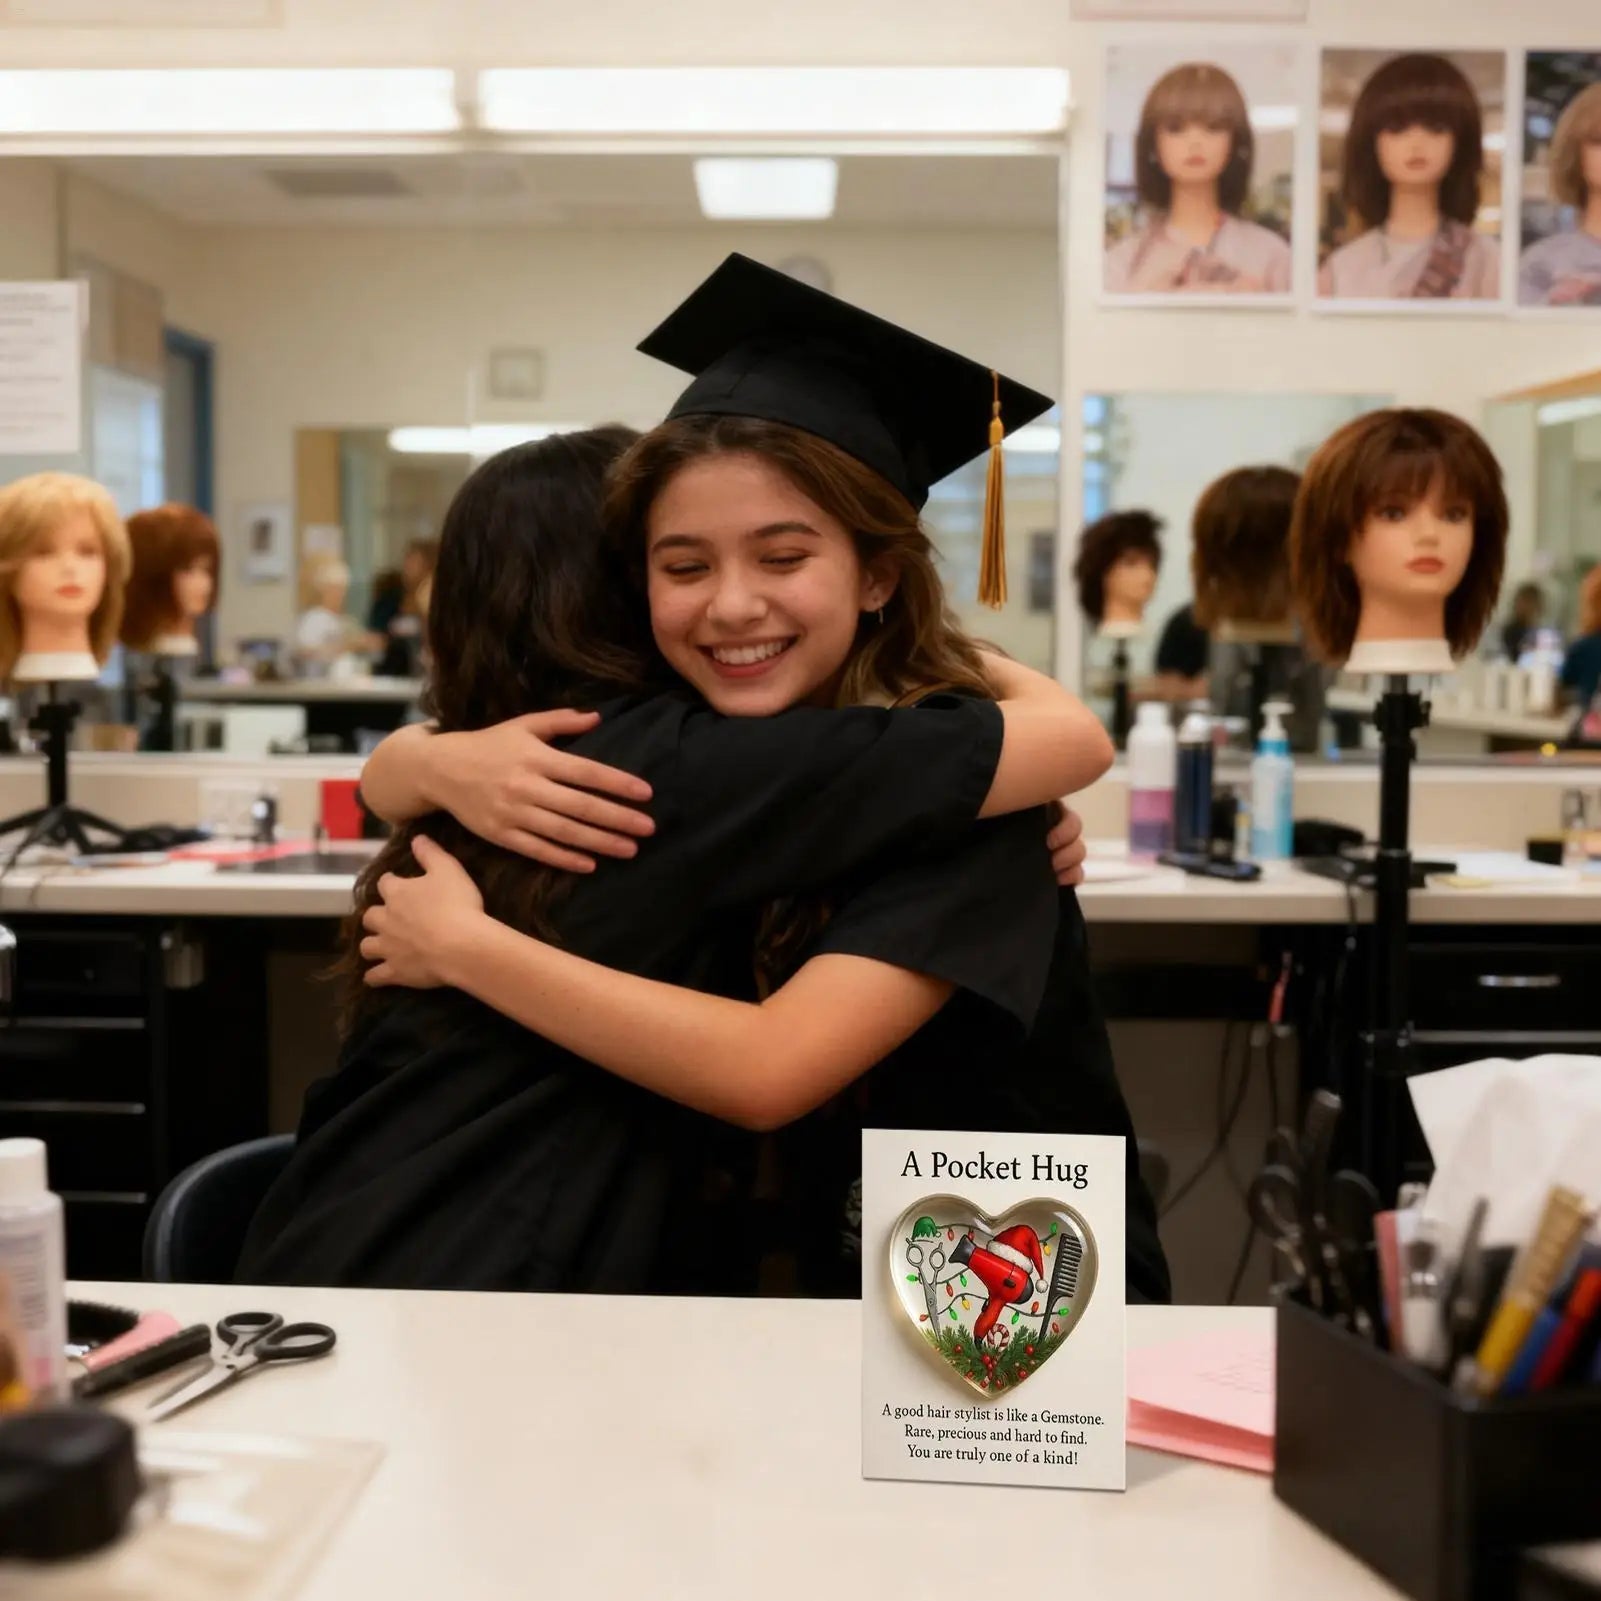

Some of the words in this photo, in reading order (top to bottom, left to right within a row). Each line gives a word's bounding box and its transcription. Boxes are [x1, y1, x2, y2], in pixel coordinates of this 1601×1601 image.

[900, 1150, 922, 1177] A
[931, 1151, 1022, 1180] Pocket
[1032, 1154, 1088, 1190] Hug
[882, 1403, 892, 1416] A
[894, 1404, 924, 1420] good
[927, 1404, 951, 1418] hair
[954, 1406, 991, 1423] stylist
[994, 1408, 1004, 1421] is
[1006, 1408, 1028, 1422] like
[1031, 1413, 1038, 1422] a
[1041, 1410, 1104, 1425] Gemstone.
[905, 1424, 935, 1439] Rare,
[938, 1426, 987, 1441] precious
[990, 1428, 1011, 1441] and
[1015, 1428, 1042, 1443] hard
[1045, 1433, 1058, 1443] to
[1061, 1430, 1087, 1445] find.
[907, 1444, 931, 1458] You
[934, 1449, 953, 1459] are
[956, 1446, 987, 1464] truly
[989, 1452, 1012, 1462] one
[1015, 1449, 1030, 1463] of
[1032, 1454, 1040, 1463] a
[1043, 1450, 1078, 1465] kind!
